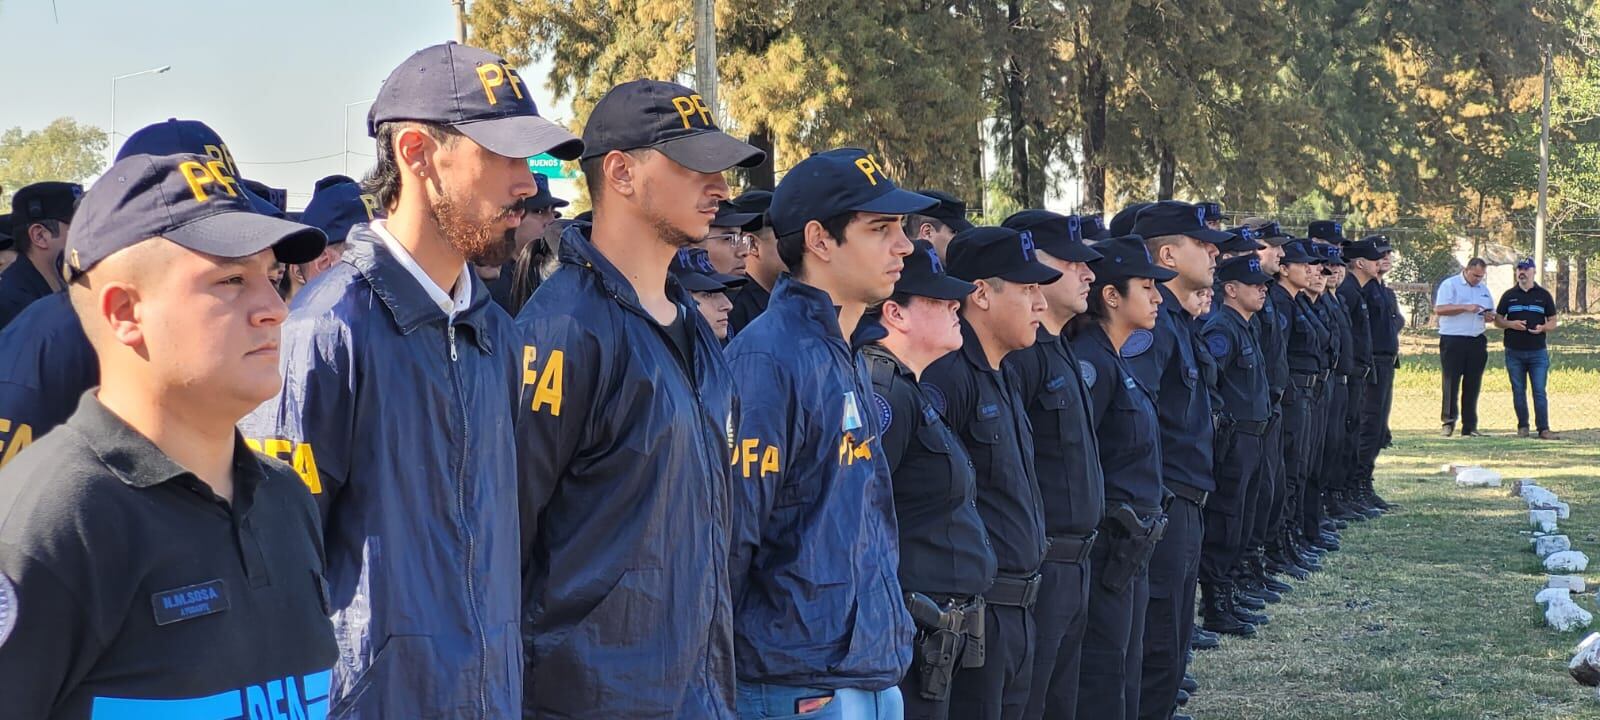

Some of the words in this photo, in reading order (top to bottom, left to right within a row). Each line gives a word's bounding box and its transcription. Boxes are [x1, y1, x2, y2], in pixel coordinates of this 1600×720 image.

[476, 63, 523, 105] PF
[179, 160, 238, 203] PF
[530, 159, 558, 167] BUENOS
